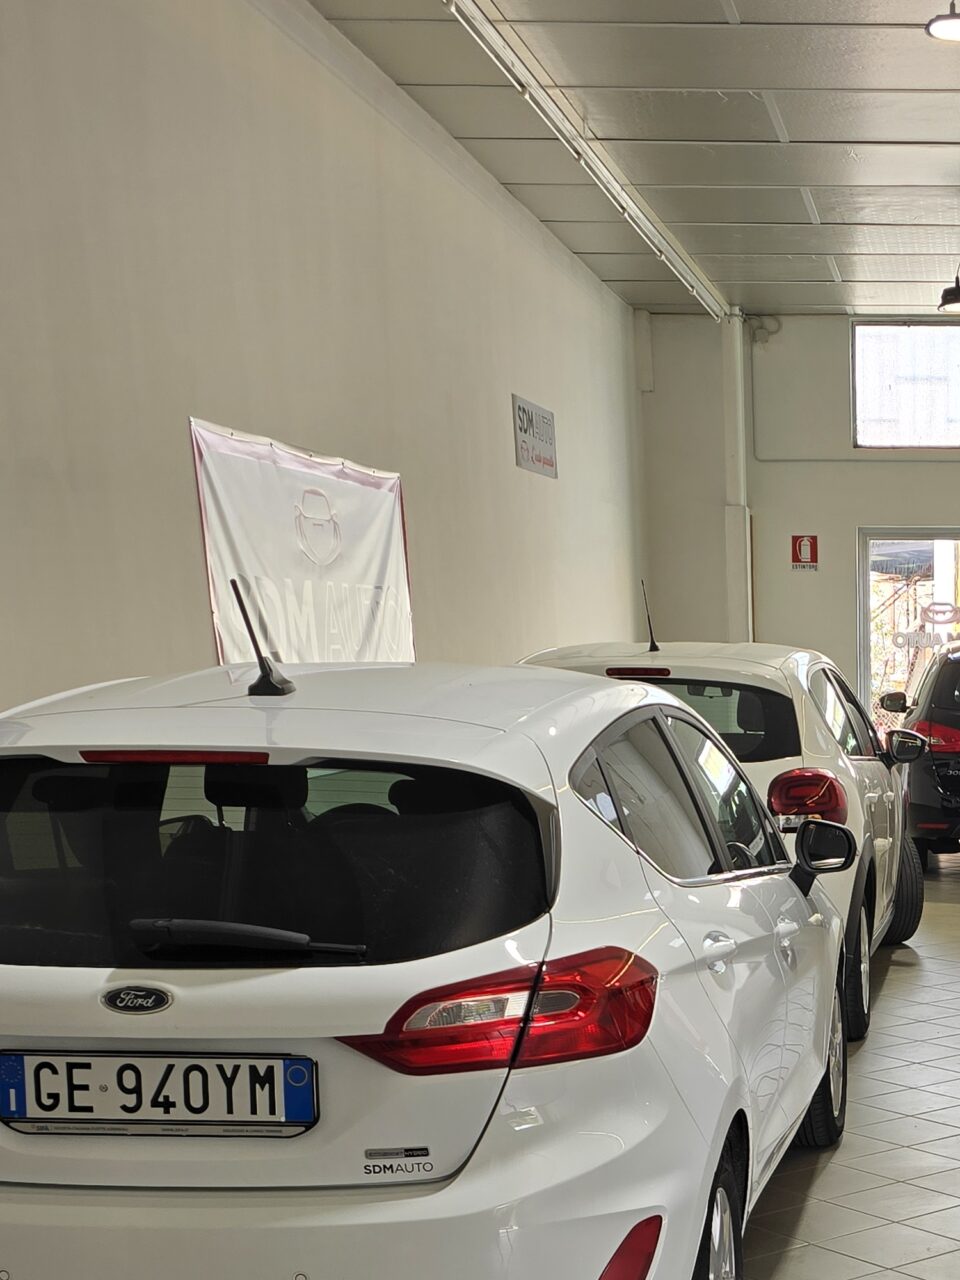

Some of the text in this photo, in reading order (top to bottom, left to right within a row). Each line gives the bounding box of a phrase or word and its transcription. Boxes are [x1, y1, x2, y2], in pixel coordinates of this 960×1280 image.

[116, 990, 156, 1007] Ford
[33, 1061, 277, 1116] GE 940YM
[364, 1162, 434, 1174] SDMAUTO
